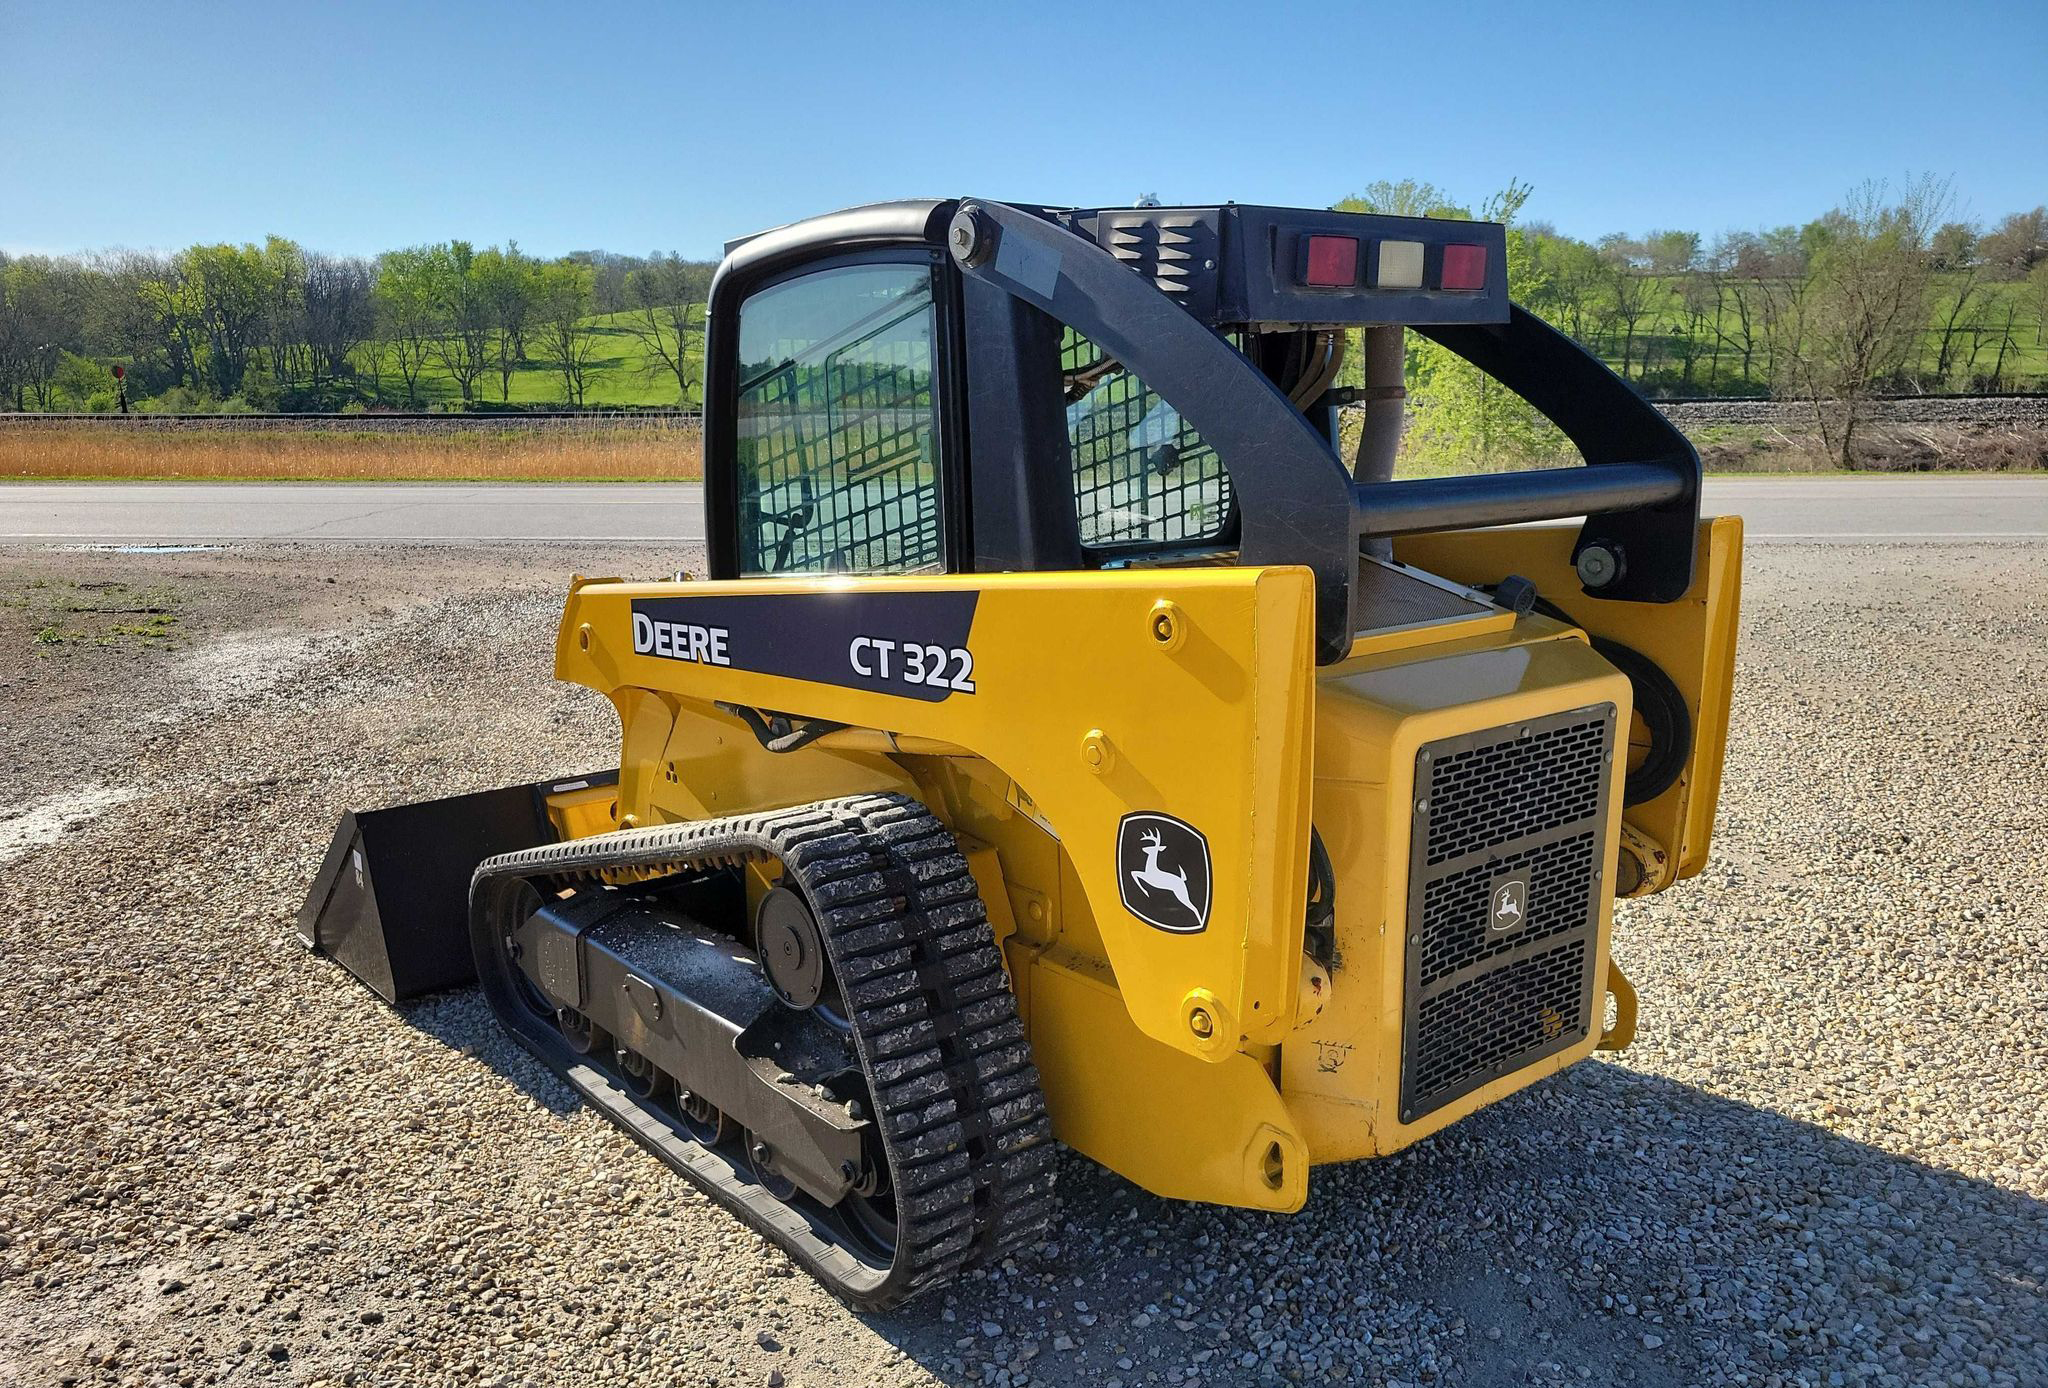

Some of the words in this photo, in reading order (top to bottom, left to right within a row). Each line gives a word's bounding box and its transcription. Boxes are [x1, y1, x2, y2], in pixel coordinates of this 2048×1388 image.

[632, 612, 730, 665] DEERE
[849, 636, 895, 679] CT
[903, 643, 974, 692] 322
